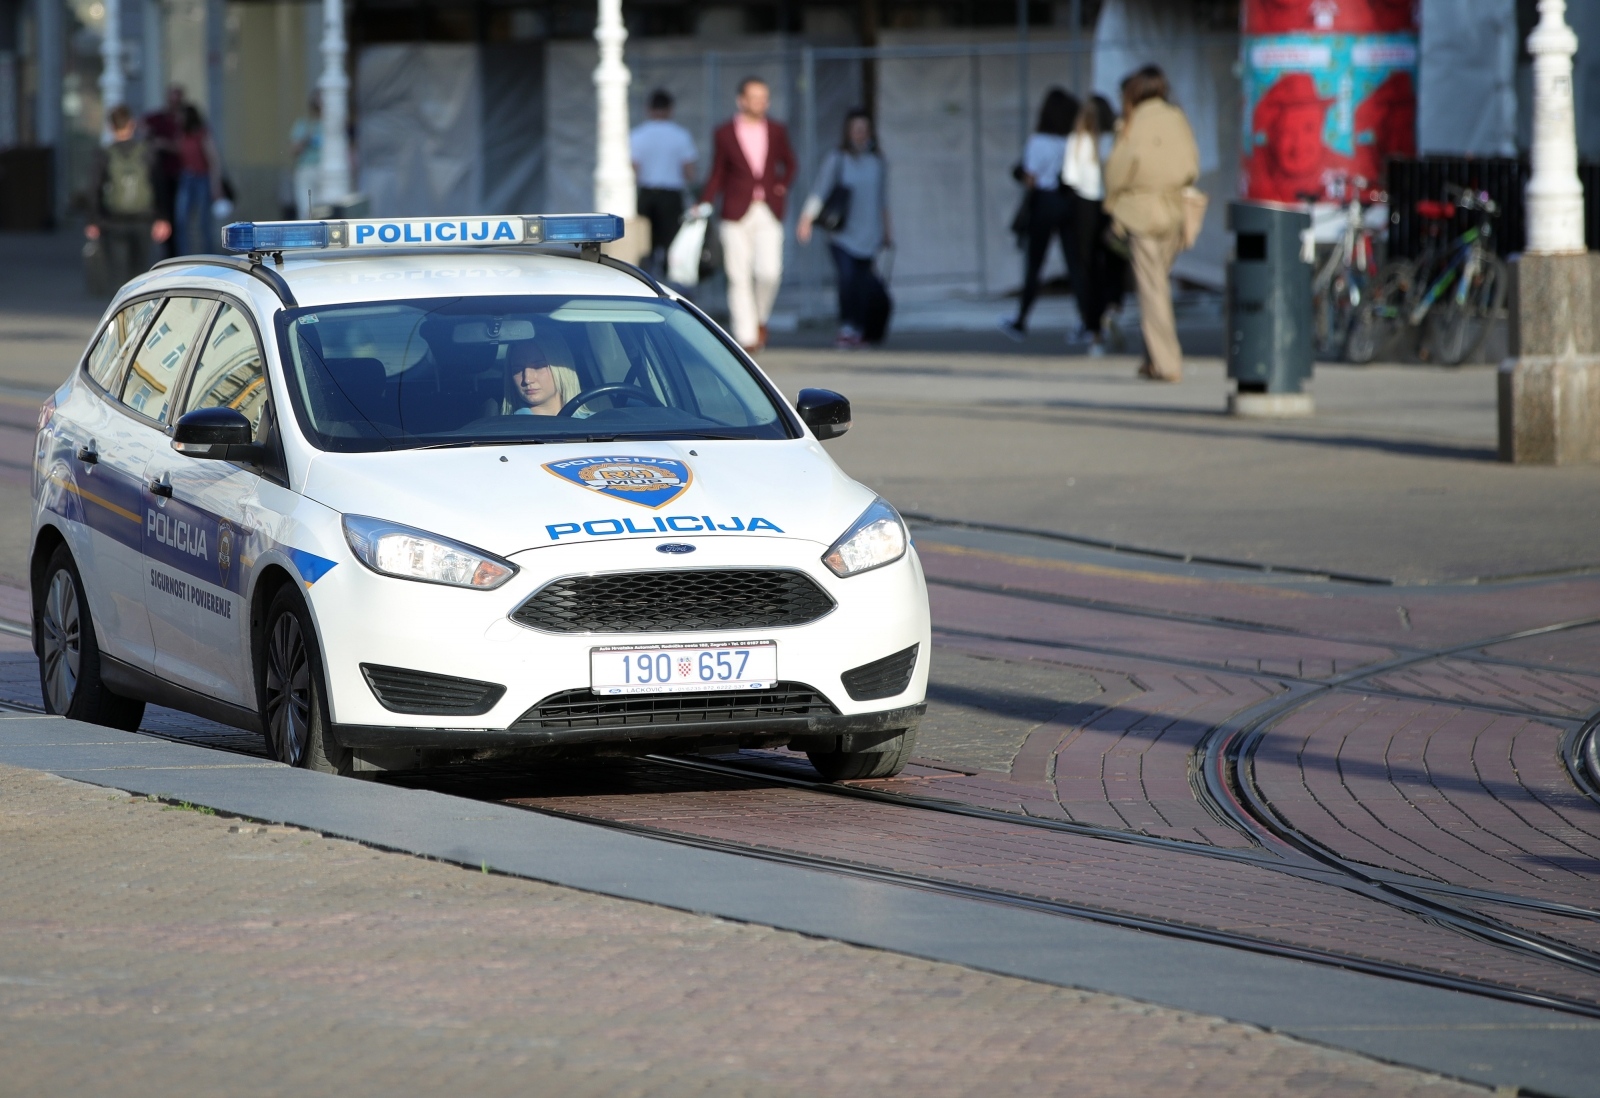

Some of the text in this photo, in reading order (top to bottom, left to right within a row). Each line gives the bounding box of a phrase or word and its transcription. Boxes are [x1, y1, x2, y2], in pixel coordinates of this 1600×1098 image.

[356, 221, 516, 244] POLICIJA
[553, 457, 678, 469] POLICIJA
[599, 469, 655, 479] RH
[147, 508, 208, 561] POLICIJA
[545, 515, 786, 540] POLICIJA
[150, 568, 231, 619] SIGURNOST I POVJERENJE
[622, 650, 750, 684] 190 657
